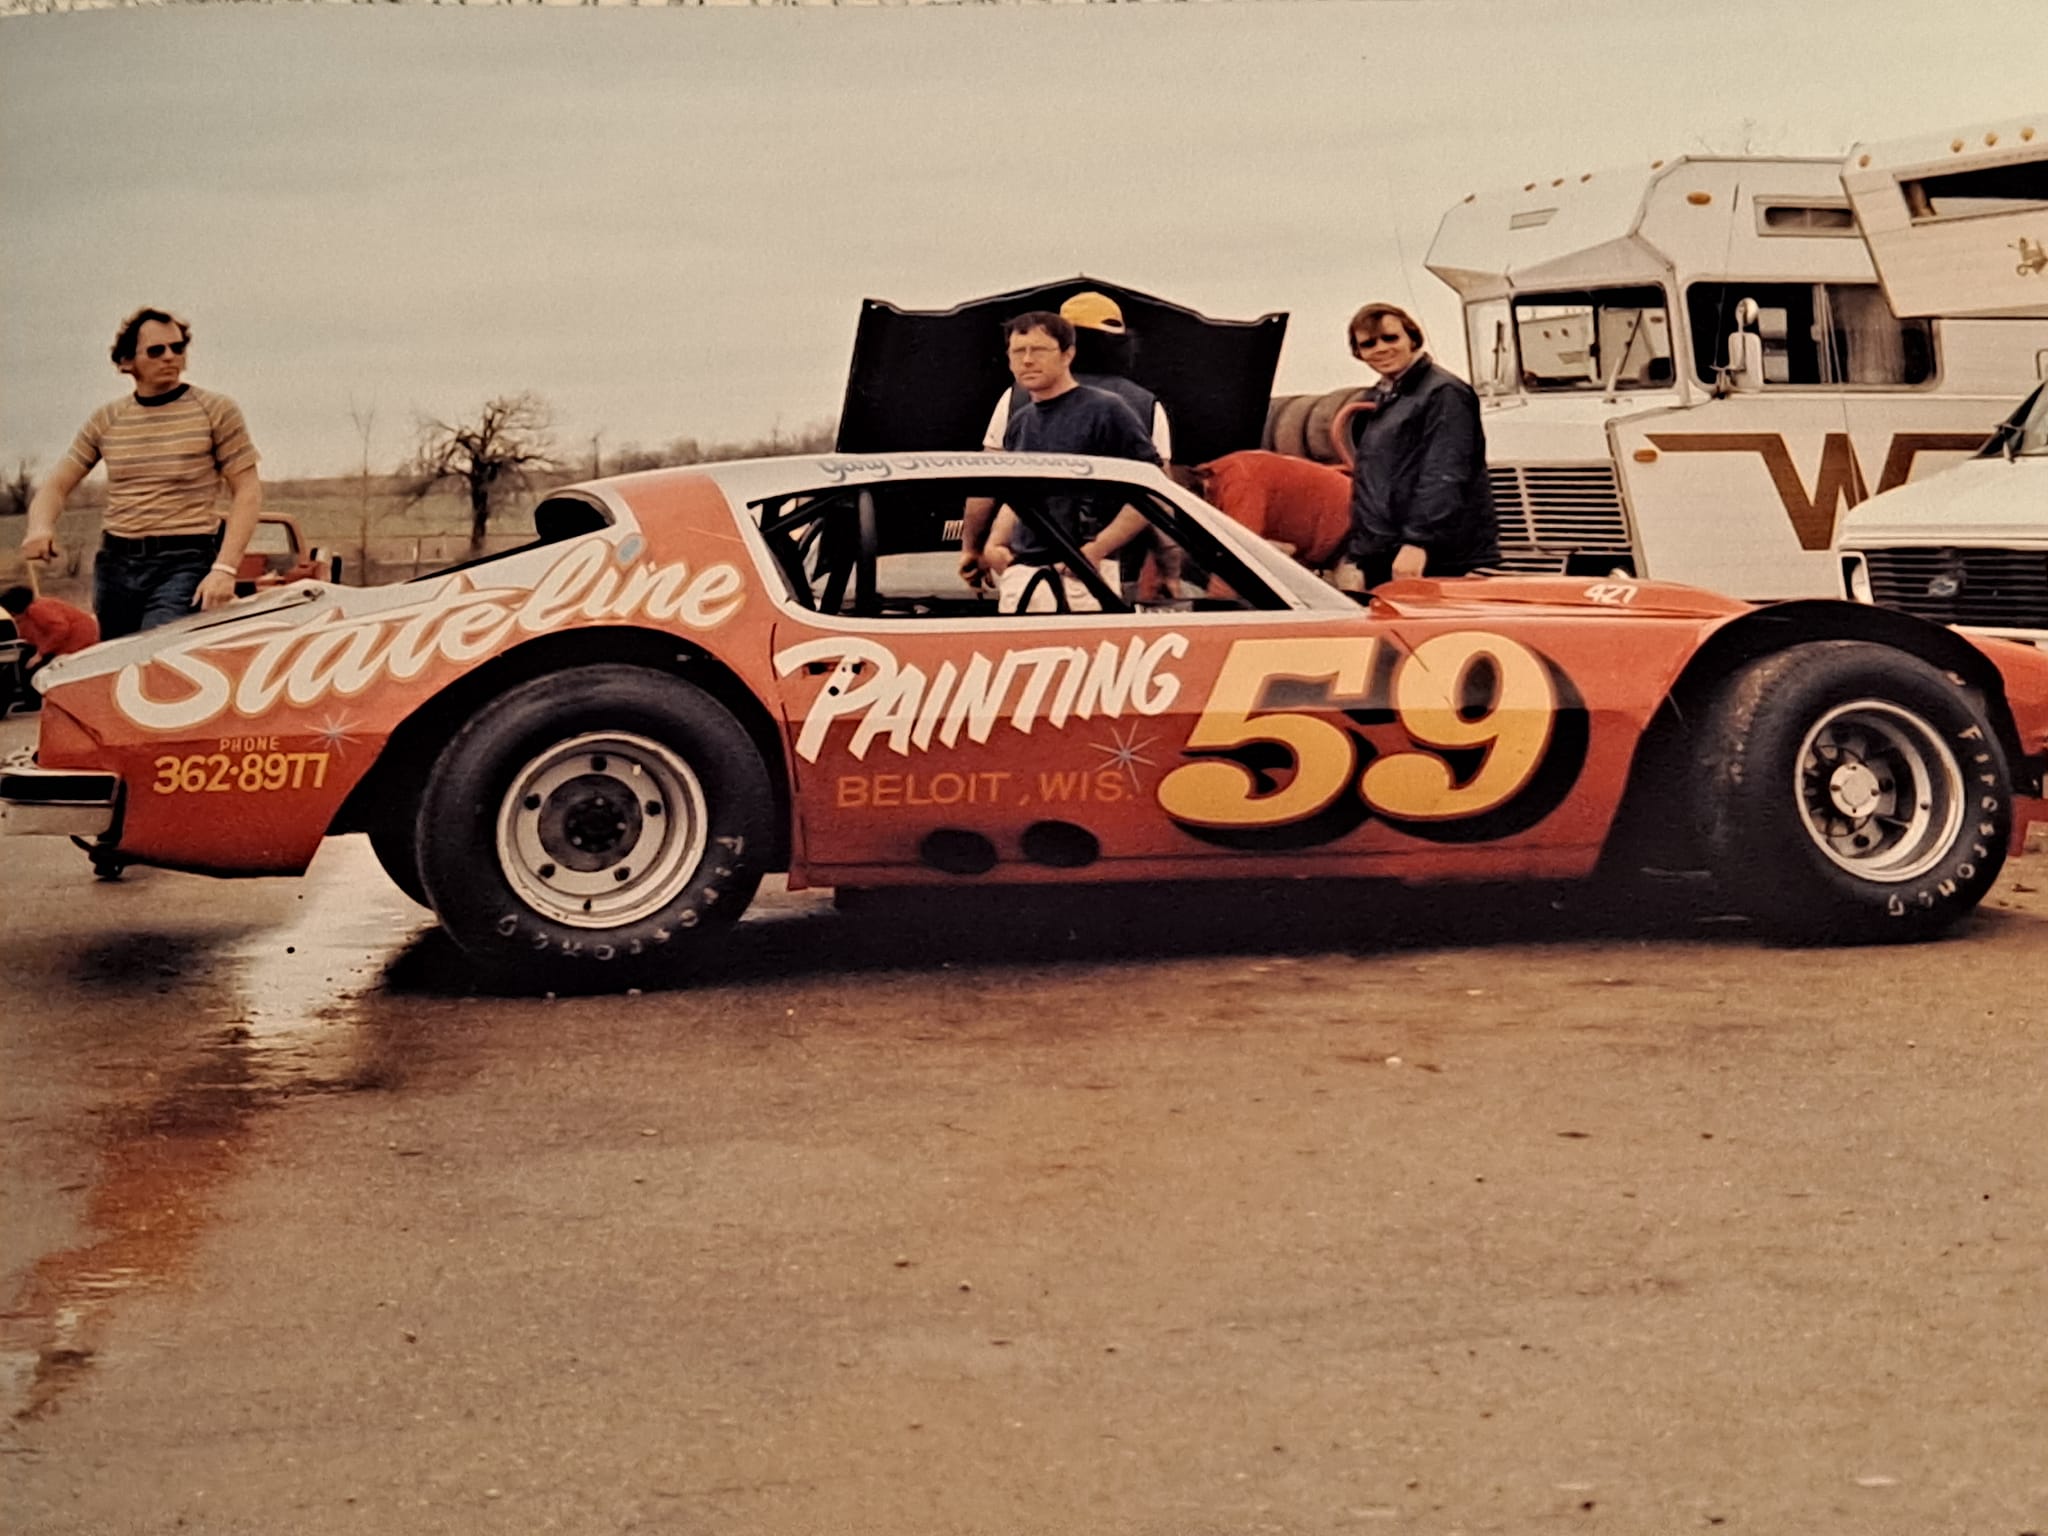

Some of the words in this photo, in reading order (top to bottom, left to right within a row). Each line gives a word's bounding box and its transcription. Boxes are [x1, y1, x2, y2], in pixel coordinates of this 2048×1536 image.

[1583, 583, 1639, 604] 427
[114, 537, 747, 732] Stateline
[773, 632, 1190, 764] PAINTING
[1156, 630, 1558, 828] 59
[219, 736, 280, 752] PHONE
[1040, 771, 1133, 801] WIS.
